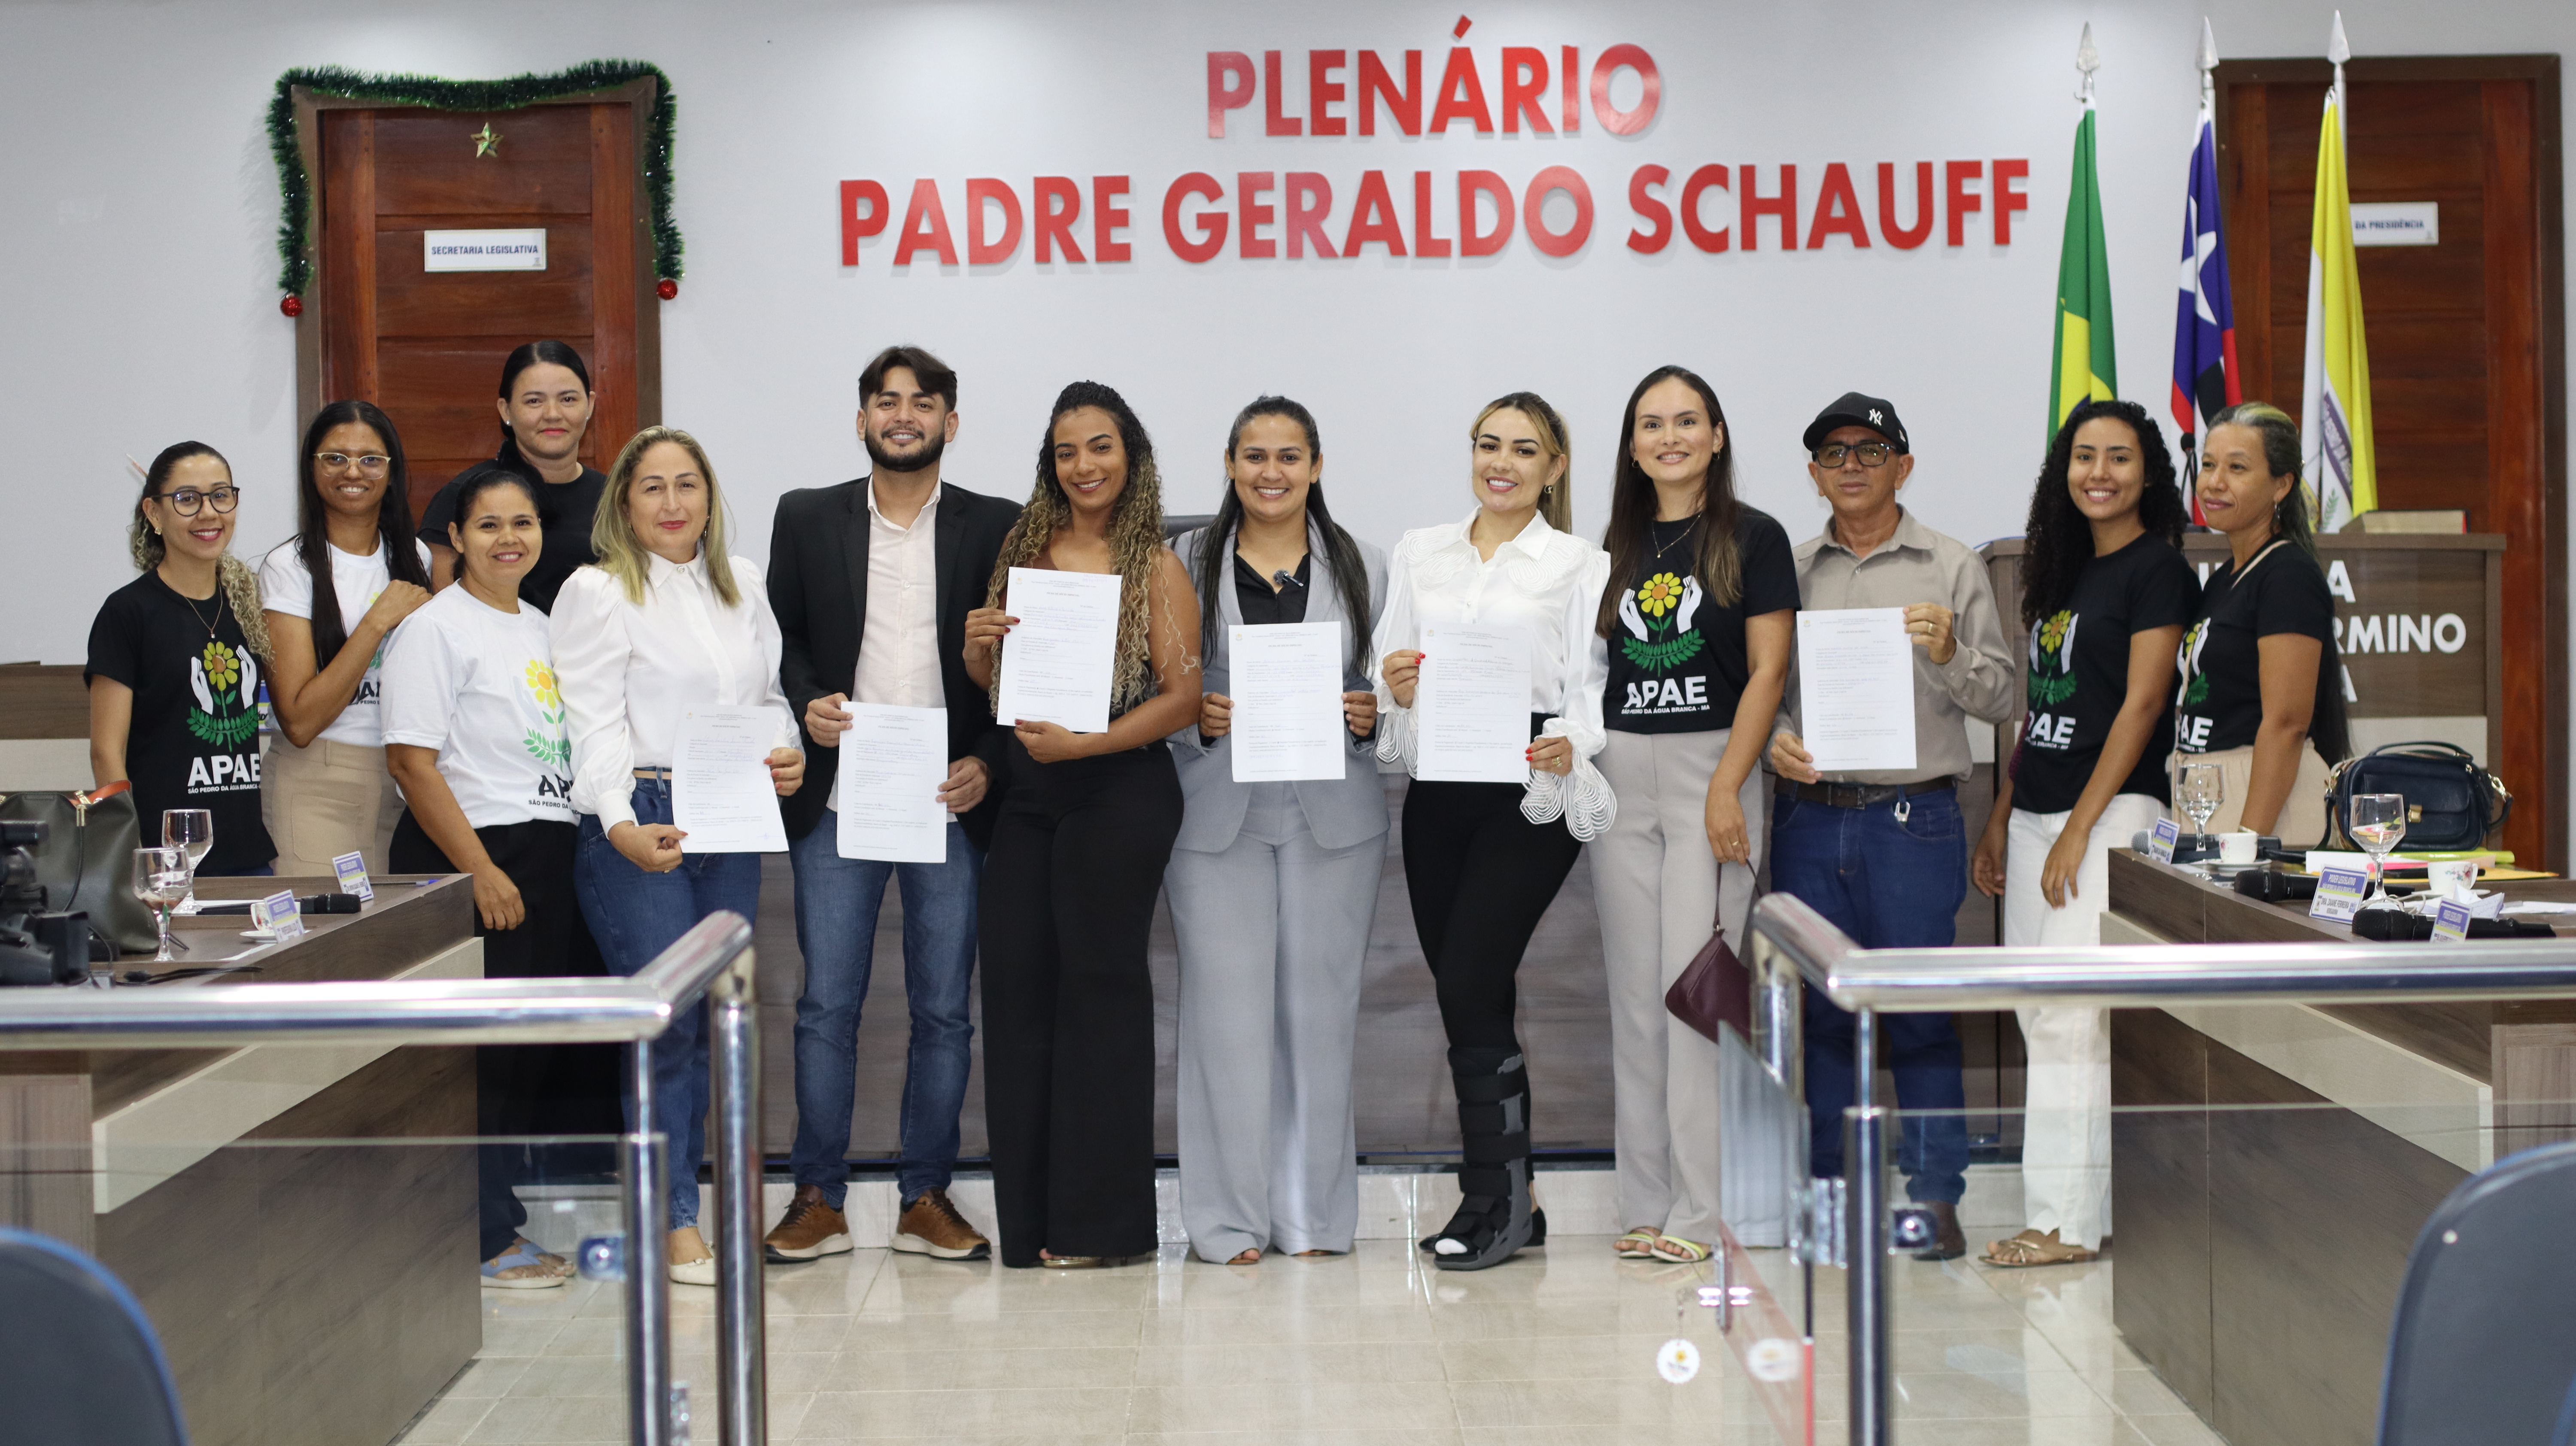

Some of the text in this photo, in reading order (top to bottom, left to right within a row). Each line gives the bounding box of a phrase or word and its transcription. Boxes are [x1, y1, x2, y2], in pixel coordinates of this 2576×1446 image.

[1207, 15, 1661, 138] PLENÁRIO
[840, 158, 2029, 267] PADRE GERALDO SCHAUFF
[2355, 218, 2424, 229] DA PRESIDÊNCIA
[431, 245, 538, 255] SECRETARIA LEGISLATIVA
[2333, 613, 2467, 653] RMINO
[1623, 675, 1708, 708] APAE
[2029, 711, 2076, 744] AE
[2180, 714, 2213, 746] AE
[187, 753, 261, 787] APAE
[538, 773, 574, 803] AP
